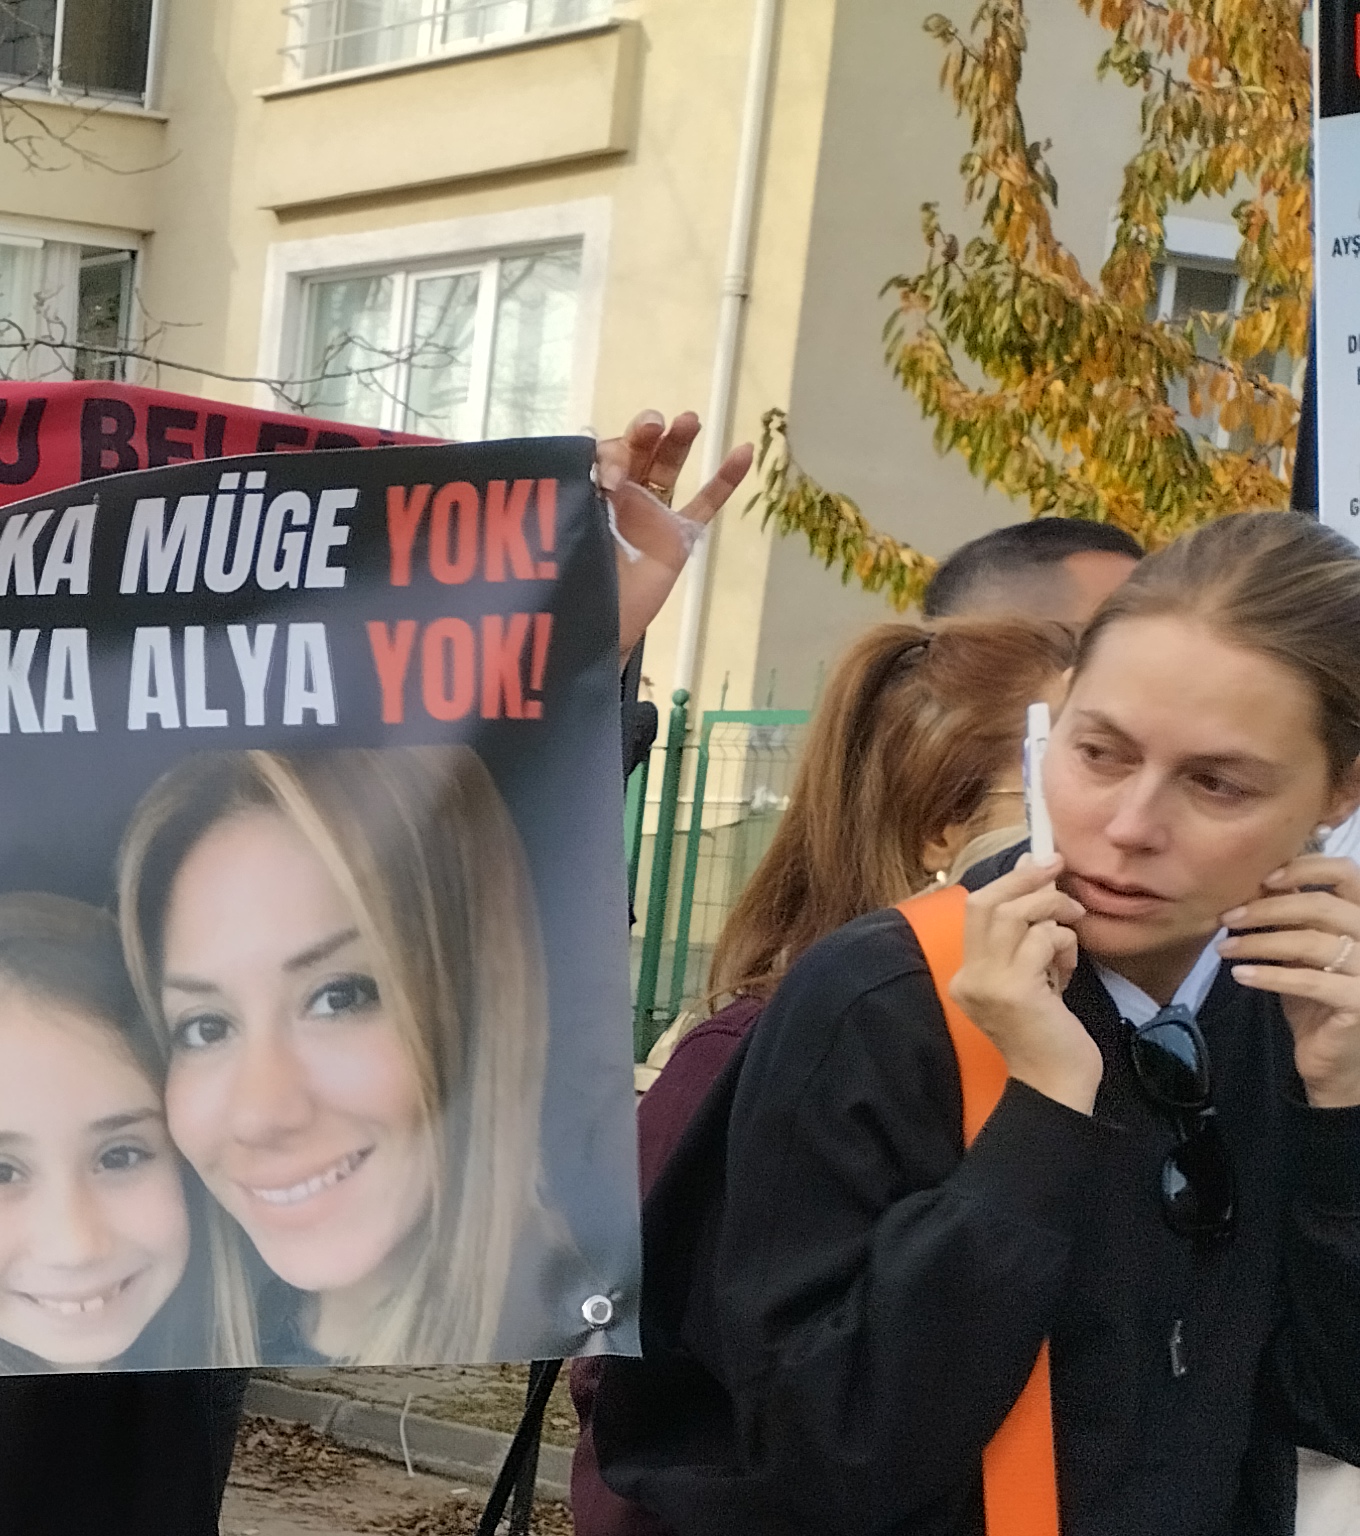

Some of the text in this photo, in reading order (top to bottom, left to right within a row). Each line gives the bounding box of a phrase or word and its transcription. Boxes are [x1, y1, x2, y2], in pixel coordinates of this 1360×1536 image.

[119, 473, 358, 596] MÜGE
[383, 478, 559, 588] YOK!
[127, 622, 338, 731] ALYA
[365, 612, 551, 726] YOK!
